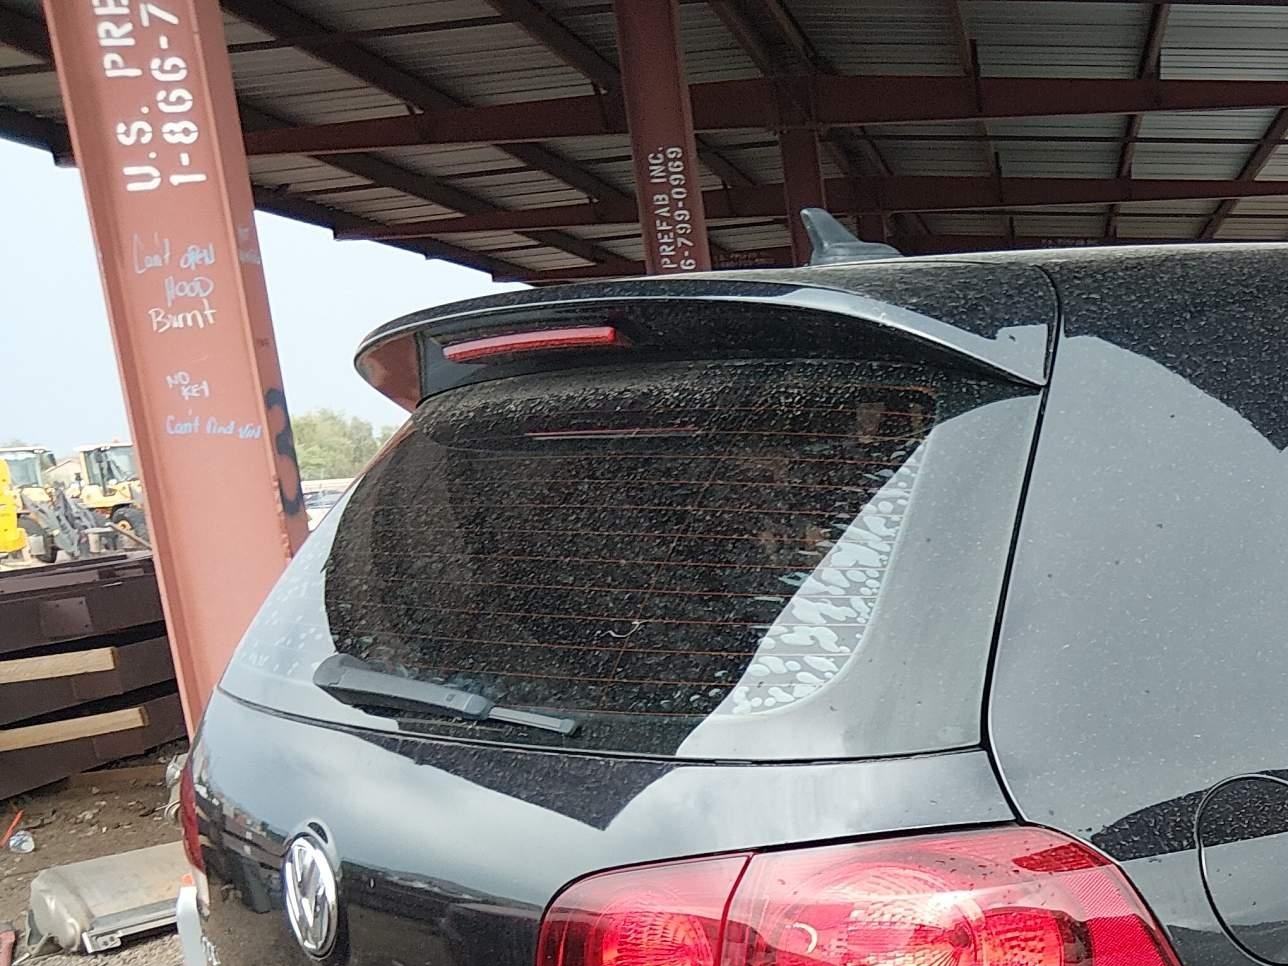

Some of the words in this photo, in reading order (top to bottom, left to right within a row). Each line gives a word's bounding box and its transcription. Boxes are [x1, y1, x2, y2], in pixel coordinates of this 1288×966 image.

[115, 105, 162, 192] U.S.
[648, 146, 668, 184] INC.
[653, 193, 678, 269] PREFAB
[666, 147, 697, 270] 6-799-0969
